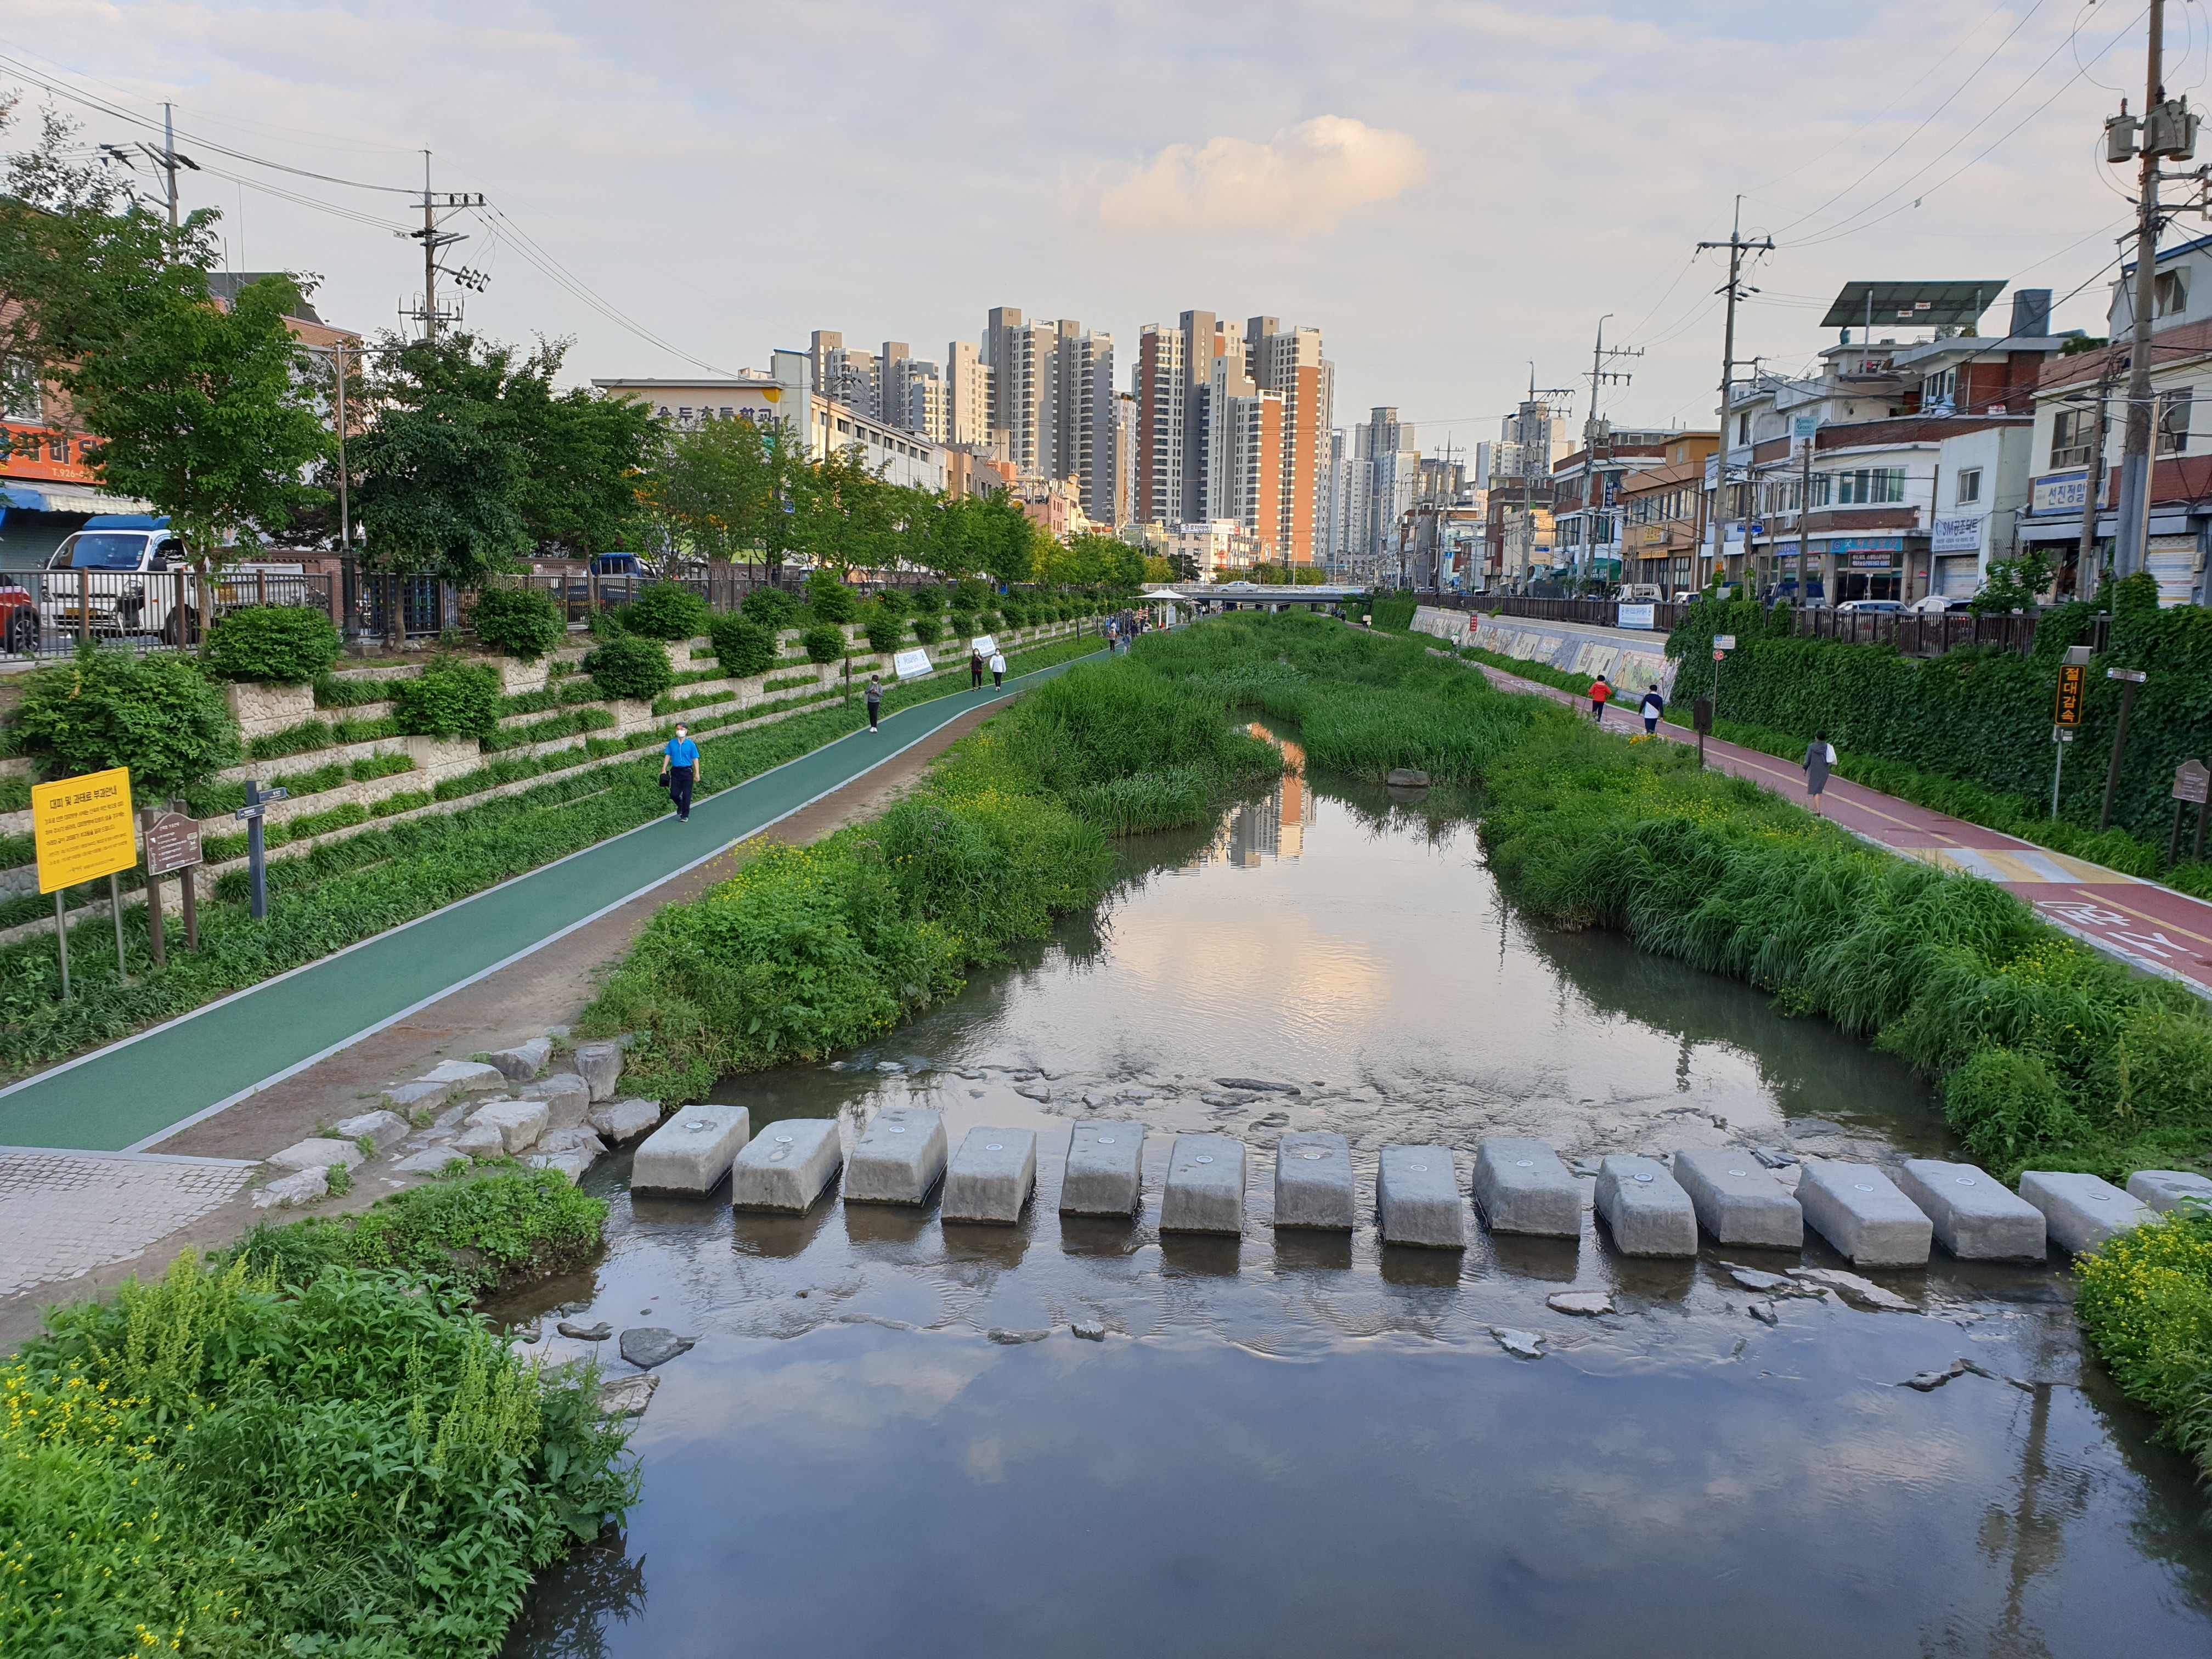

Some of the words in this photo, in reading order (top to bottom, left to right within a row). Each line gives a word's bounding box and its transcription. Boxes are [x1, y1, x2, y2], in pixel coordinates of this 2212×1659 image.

[2061, 668, 2079, 723] 절대감속
[49, 798, 63, 809] 대피
[65, 796, 72, 806] 및
[74, 791, 92, 804] 과태료
